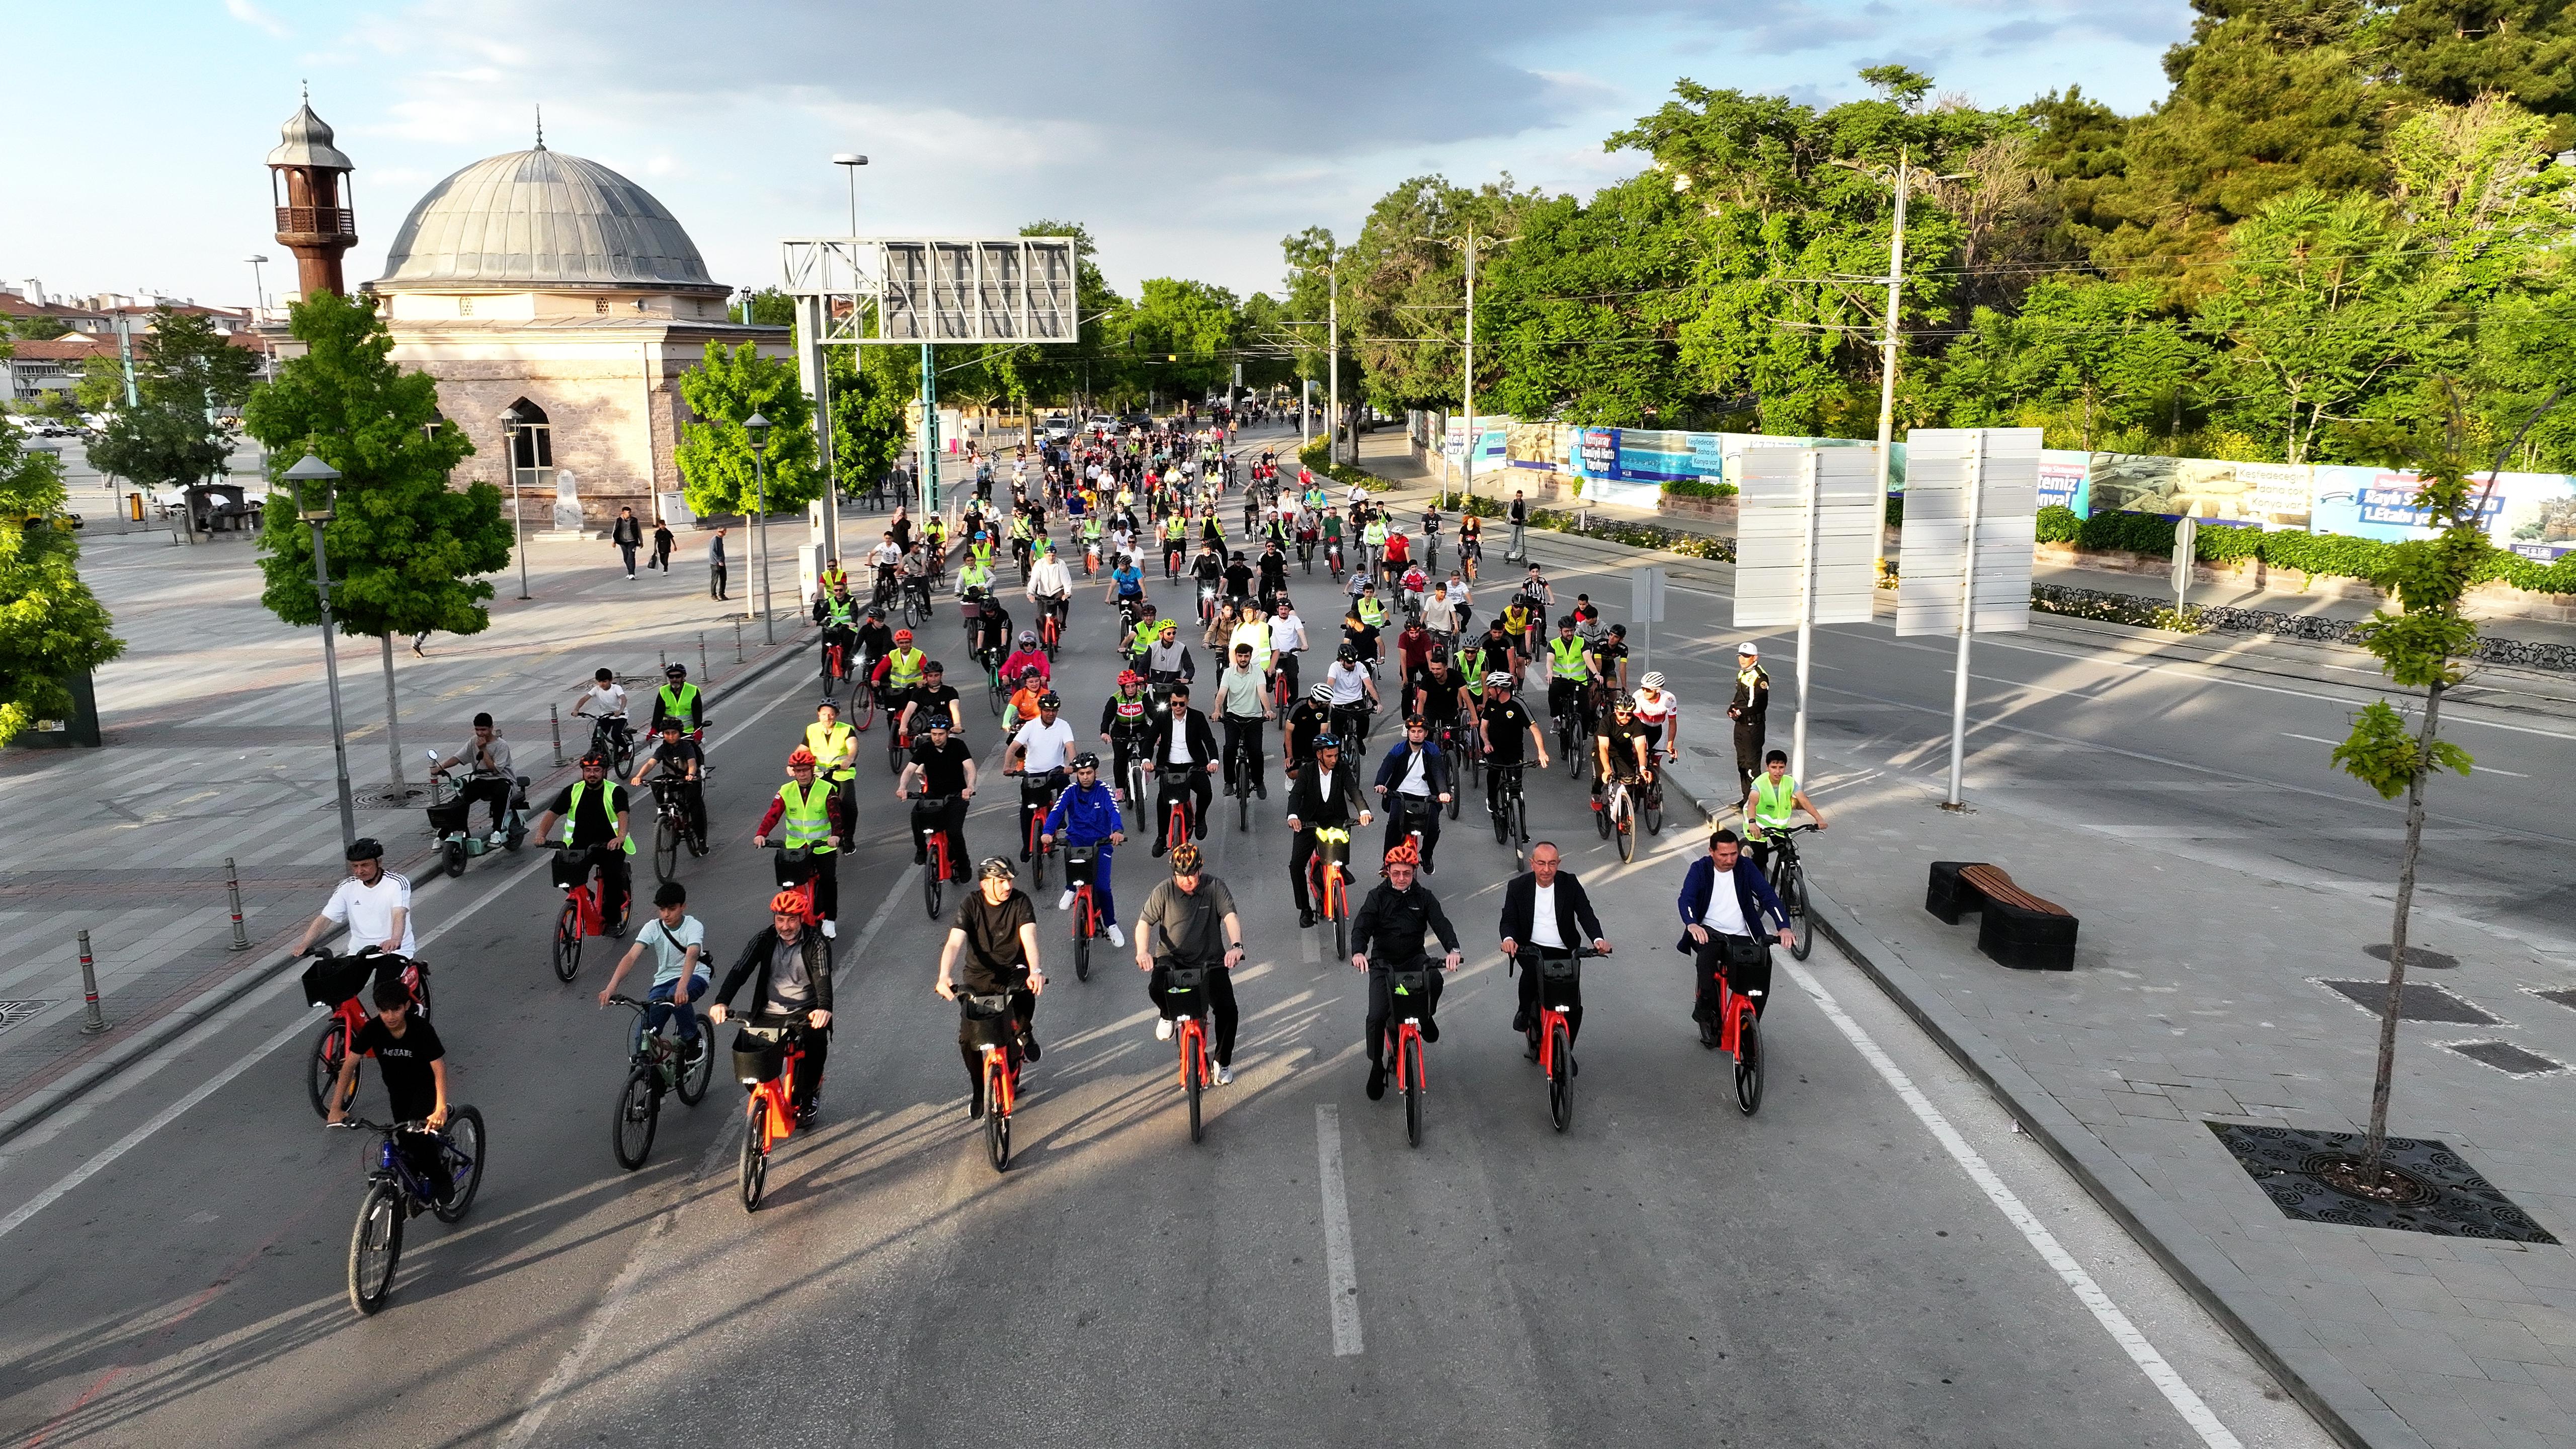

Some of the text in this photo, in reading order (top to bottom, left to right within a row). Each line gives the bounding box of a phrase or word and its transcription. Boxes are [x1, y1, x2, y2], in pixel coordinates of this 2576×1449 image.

[1585, 434, 1610, 447] Konyaray
[1582, 446, 1615, 459] Banliyö Hattı
[1586, 458, 1609, 472] Yapılıyor
[1694, 457, 1708, 466] Konya
[2260, 485, 2304, 497] daha çok
[2252, 498, 2282, 510] Konya
[2364, 506, 2412, 523] 1.Etabı
